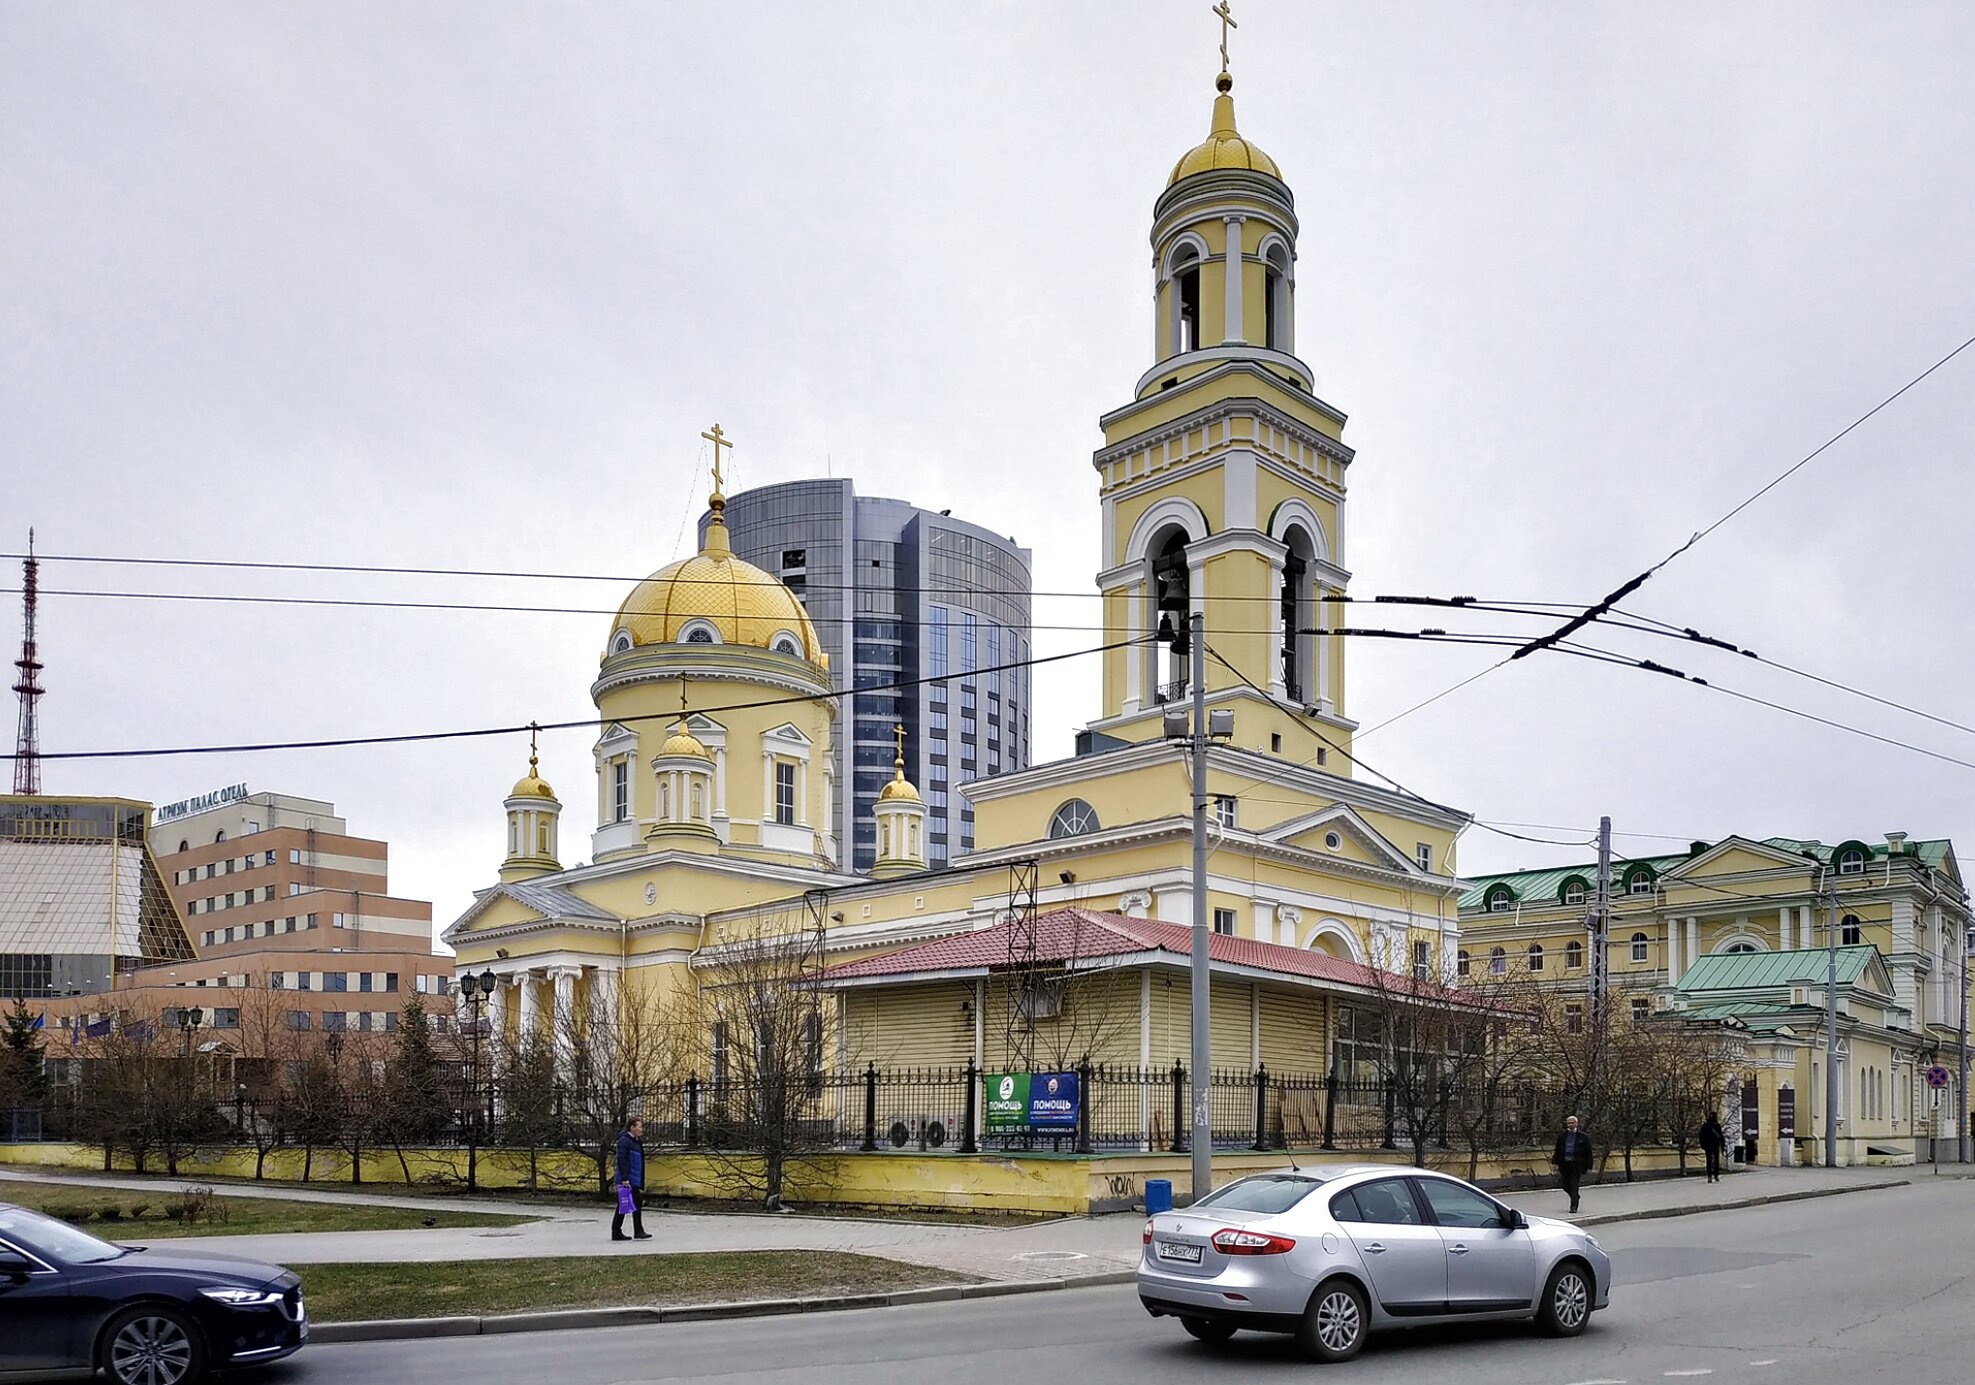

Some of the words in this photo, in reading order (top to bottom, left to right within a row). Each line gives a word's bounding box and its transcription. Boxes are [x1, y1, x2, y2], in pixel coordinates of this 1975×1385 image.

[157, 799, 188, 821] АТРИУМ
[190, 790, 220, 811] ПАЛАС
[989, 1100, 1023, 1111] ПОМОЩЬ
[1033, 1100, 1071, 1111] ПОМОЩЬ
